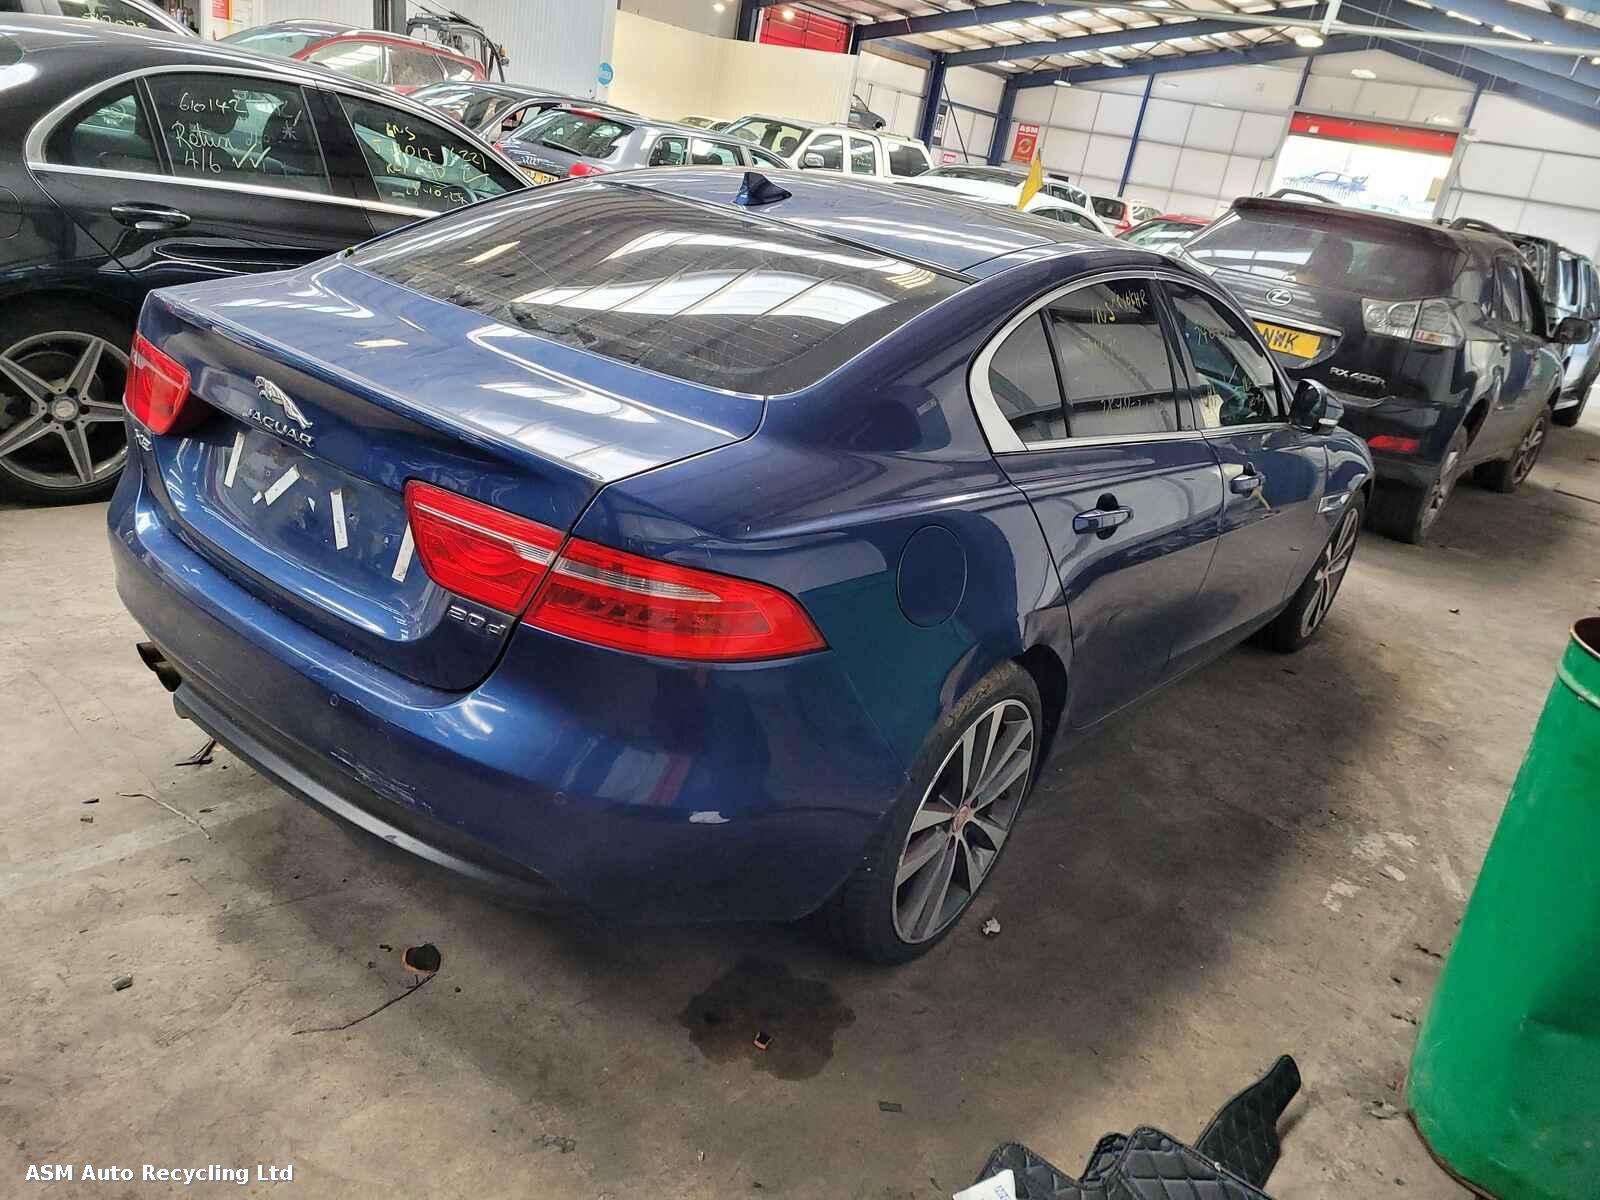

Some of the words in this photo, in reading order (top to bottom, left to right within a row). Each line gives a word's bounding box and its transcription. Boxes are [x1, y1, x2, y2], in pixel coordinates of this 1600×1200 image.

[1019, 124, 1040, 134] ASM
[1330, 366, 1349, 378] RX
[243, 408, 316, 448] JAGUAR
